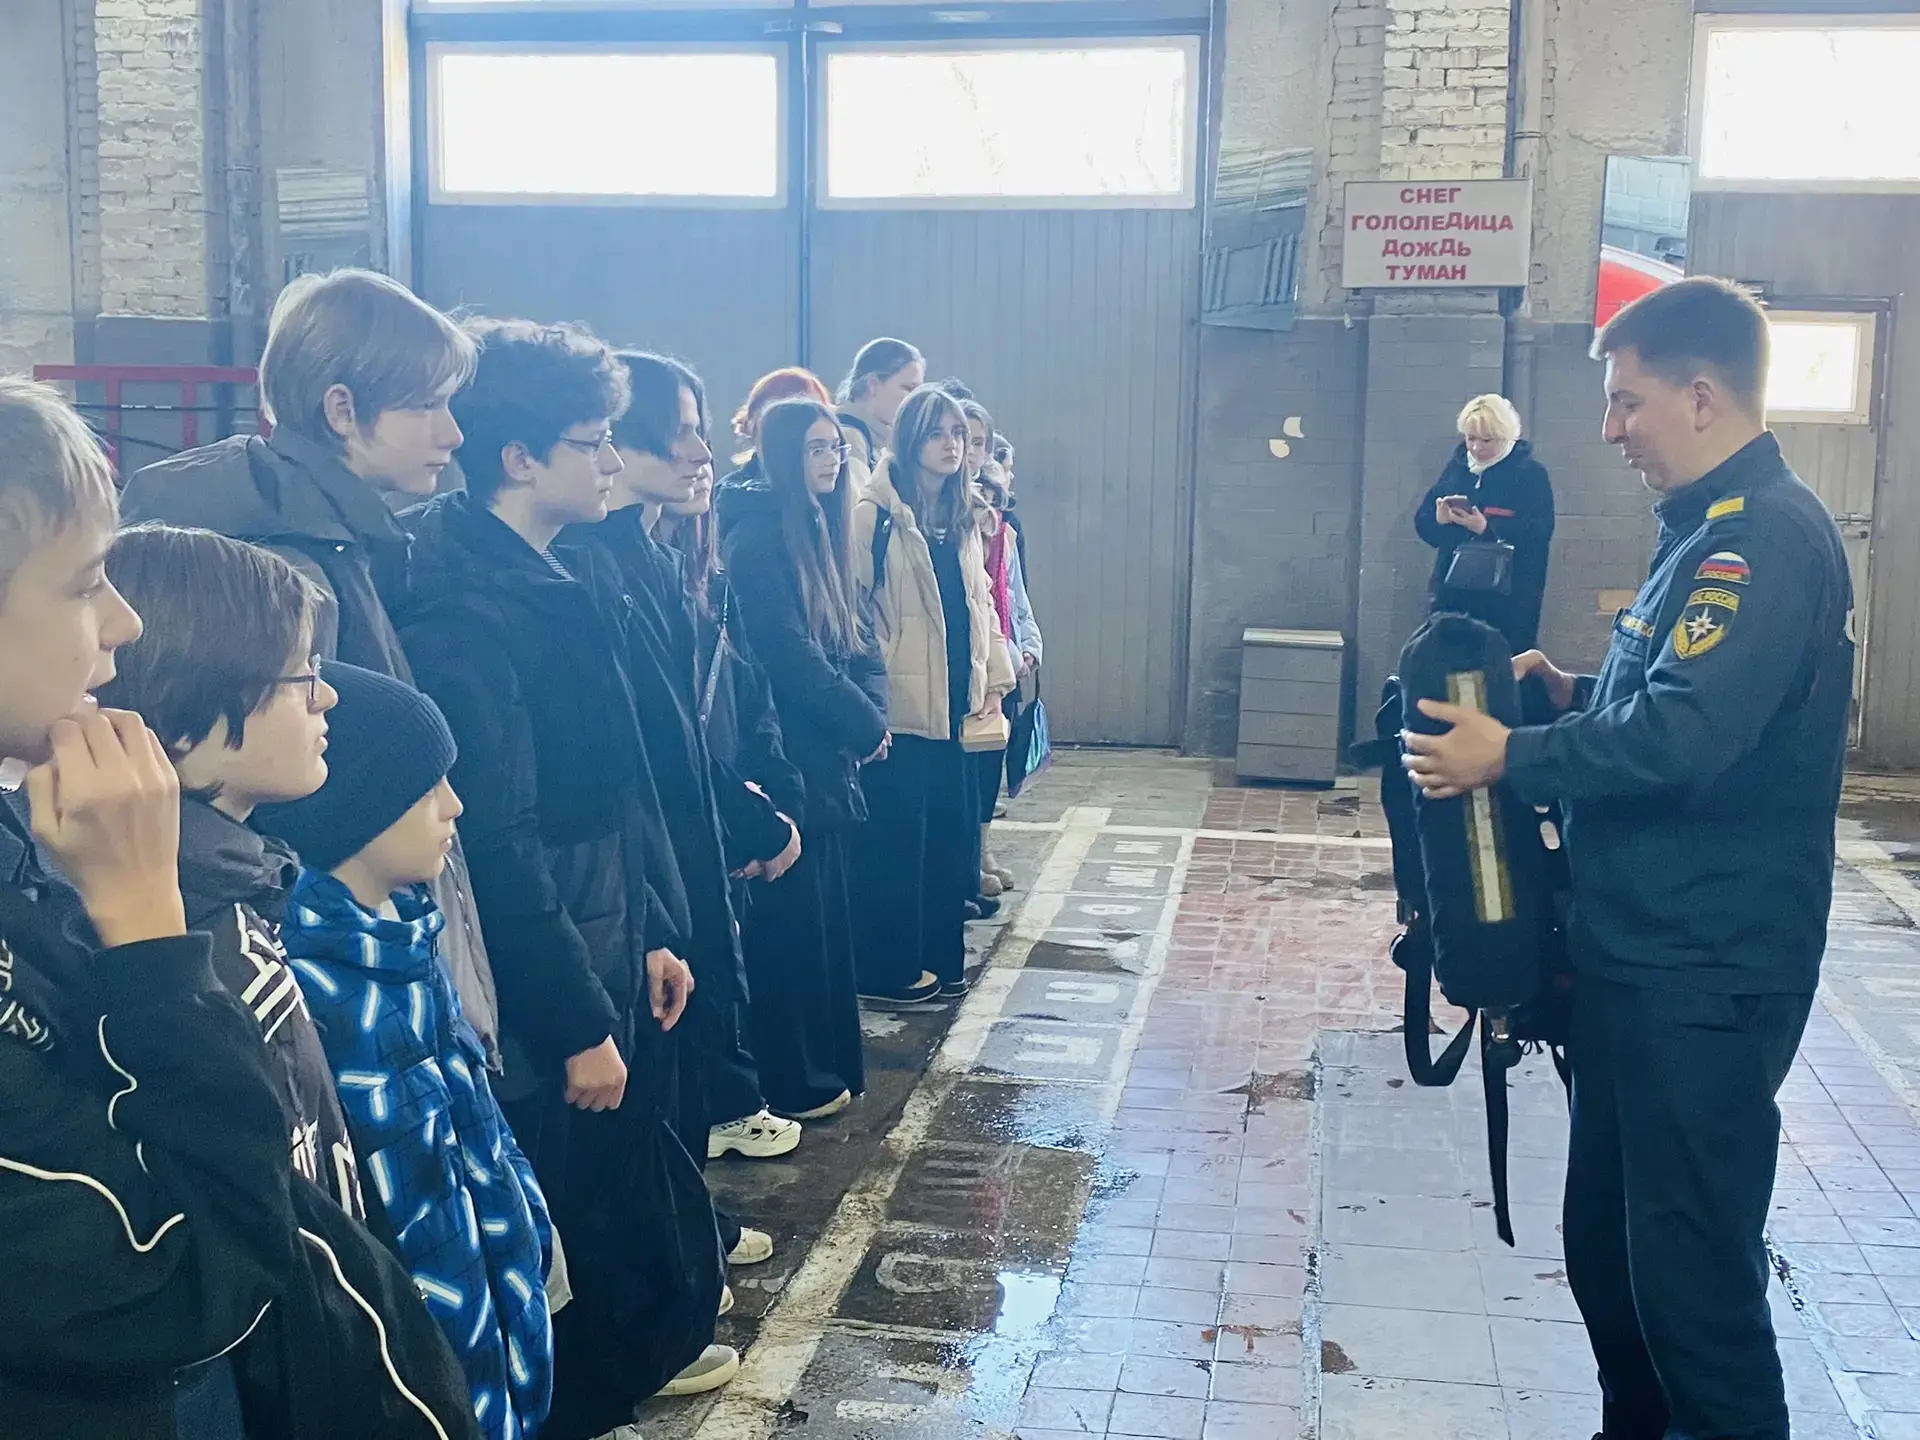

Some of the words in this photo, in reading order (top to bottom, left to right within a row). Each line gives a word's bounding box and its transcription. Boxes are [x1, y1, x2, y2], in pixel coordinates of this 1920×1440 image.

[1400, 187, 1462, 204] СНЕГ
[1351, 212, 1514, 233] ГОЛОЛЕДИЦА
[1381, 238, 1472, 258] ДОЖДЬ
[1386, 265, 1467, 281] ТУМАН
